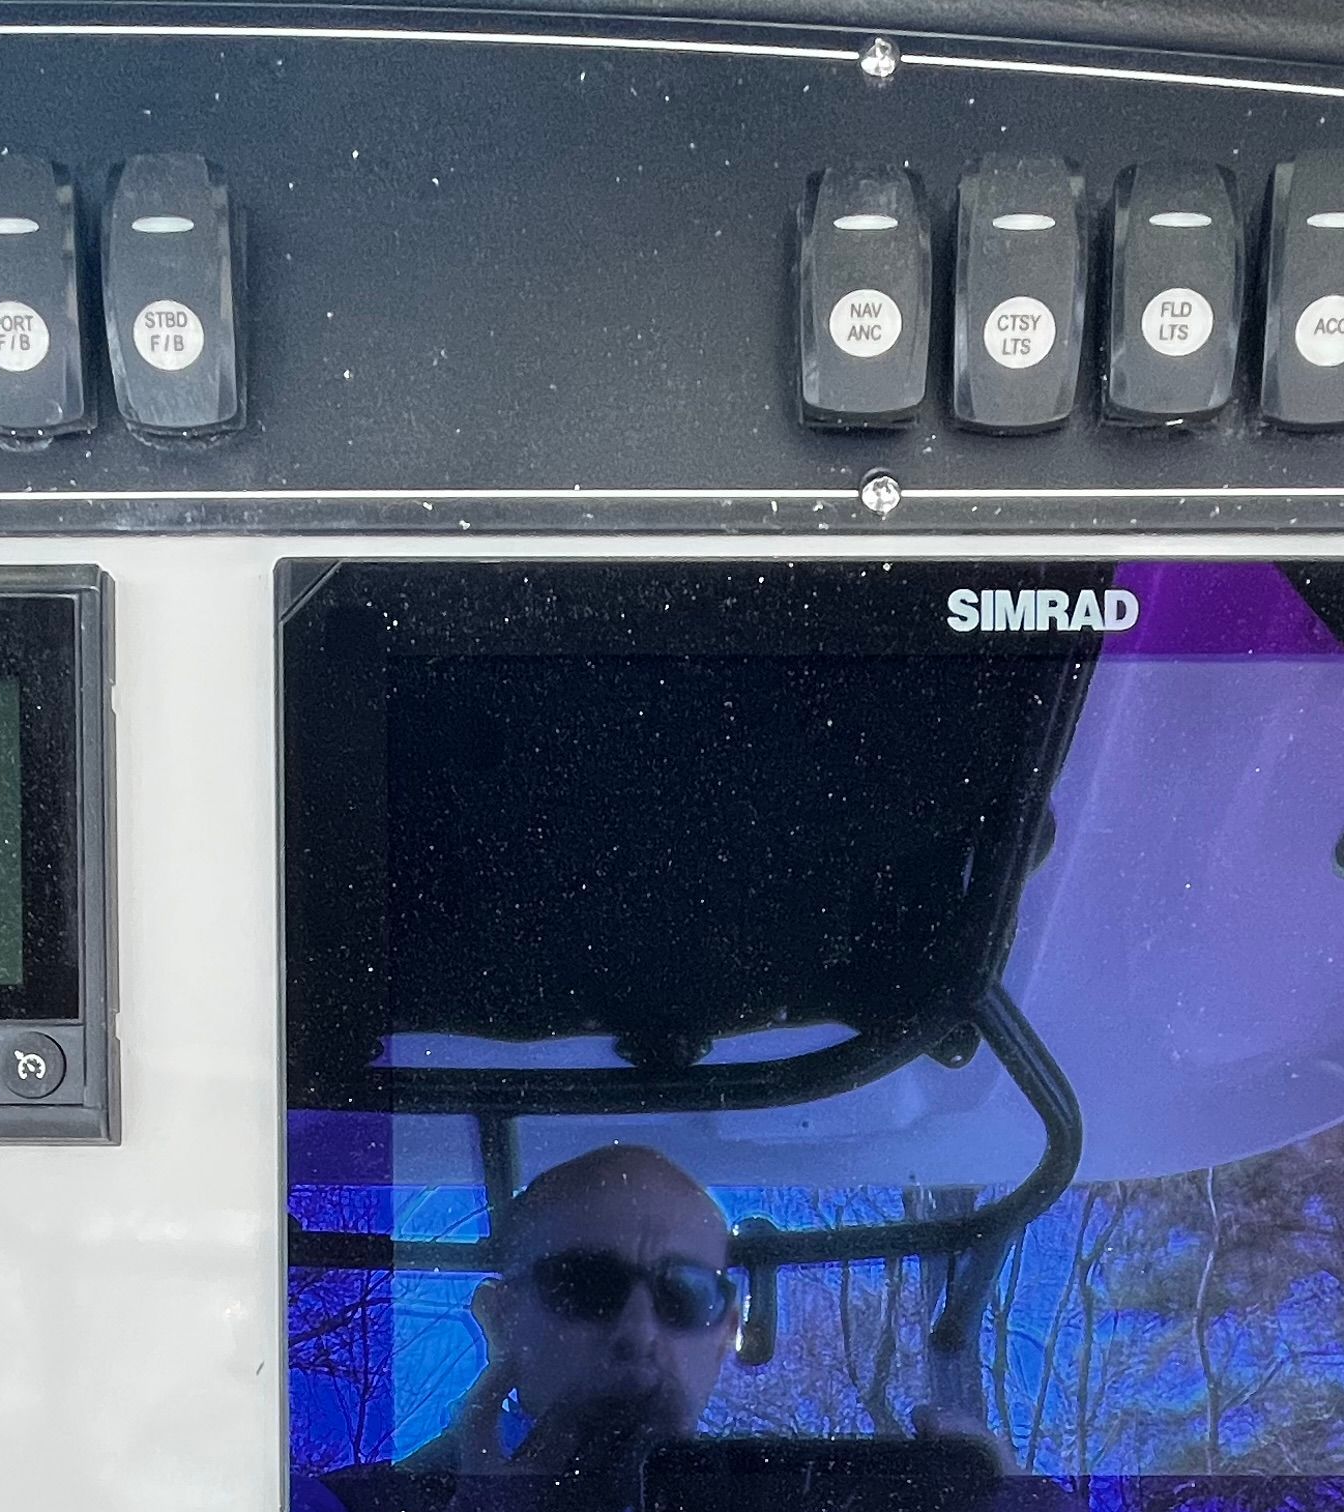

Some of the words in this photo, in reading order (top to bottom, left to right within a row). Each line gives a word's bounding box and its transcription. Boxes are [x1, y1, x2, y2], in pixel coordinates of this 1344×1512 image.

[850, 303, 882, 319] NAV
[1161, 301, 1192, 318] FLD
[144, 311, 188, 329] STBD
[997, 315, 1041, 332] CTSY
[847, 325, 883, 342] ANC
[1159, 324, 1189, 341] LTS
[1002, 338, 1031, 355] LTS
[947, 588, 1139, 632] SIMRAD
